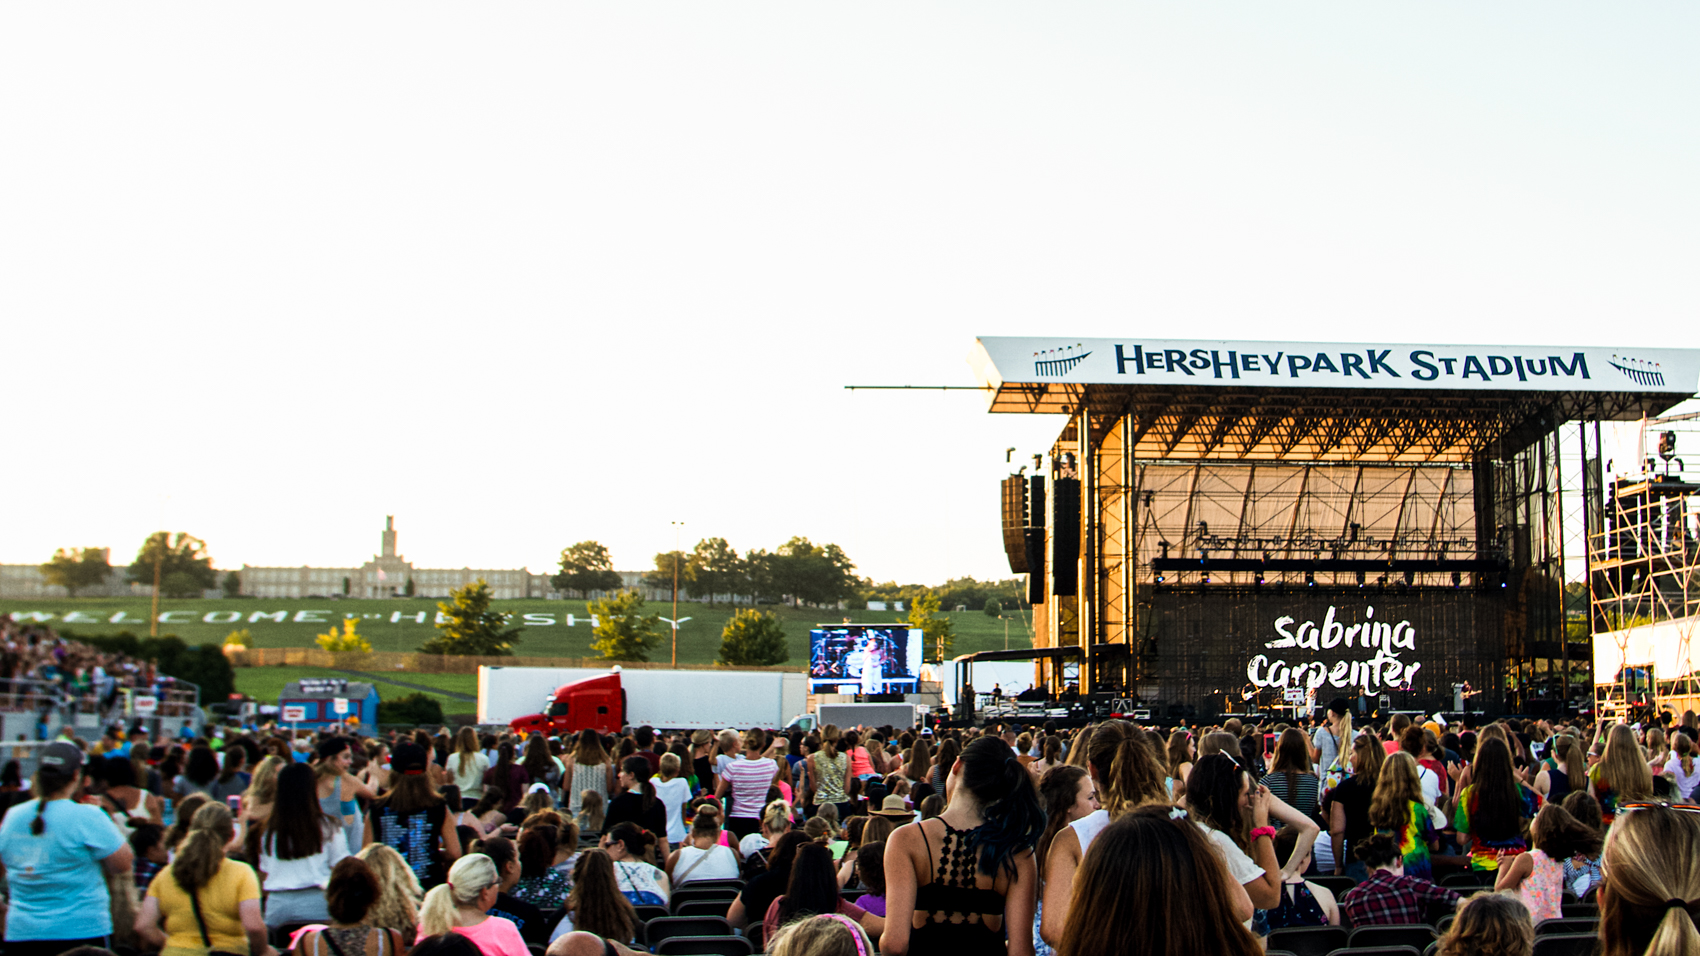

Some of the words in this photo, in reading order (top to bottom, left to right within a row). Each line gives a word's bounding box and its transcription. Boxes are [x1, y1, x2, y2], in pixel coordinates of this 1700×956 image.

[1114, 344, 1402, 379] HERSHEYPARK
[1409, 350, 1591, 381] STADIUM
[9, 610, 333, 624] WELCOME
[1264, 605, 1416, 657] Sabrina
